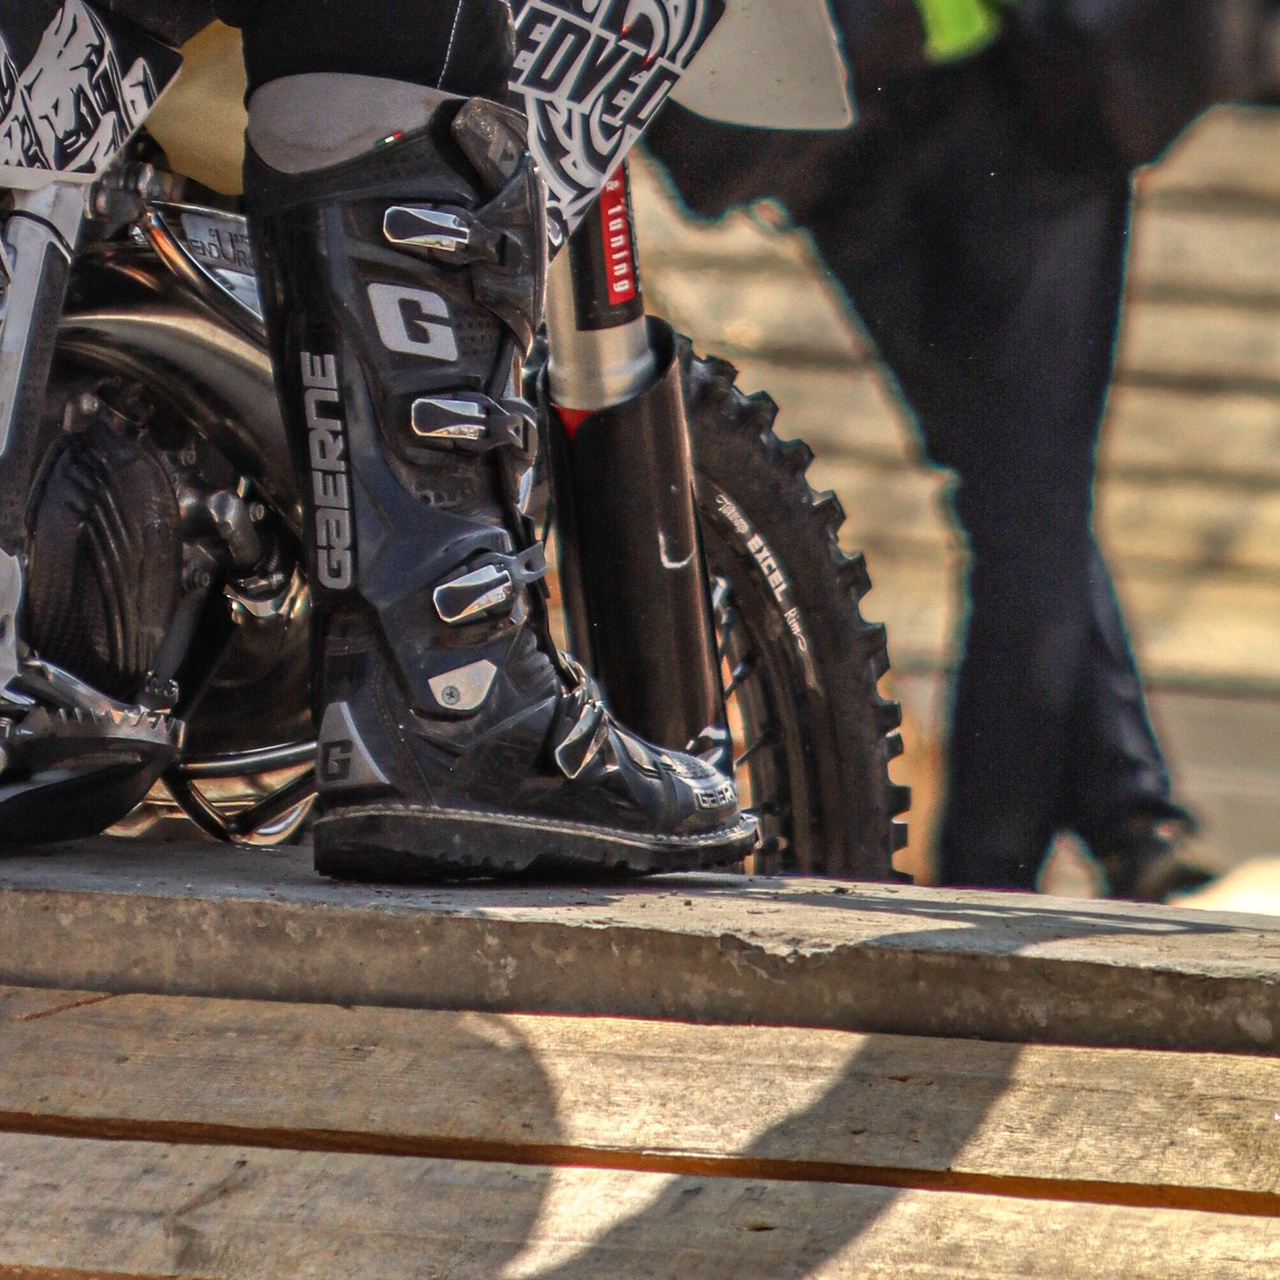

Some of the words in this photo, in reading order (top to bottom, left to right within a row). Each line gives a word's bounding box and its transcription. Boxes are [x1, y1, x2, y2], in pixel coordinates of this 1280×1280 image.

[607, 203, 631, 293] tuning
[300, 351, 353, 590] GAERNE
[747, 532, 788, 603] EXCEL
